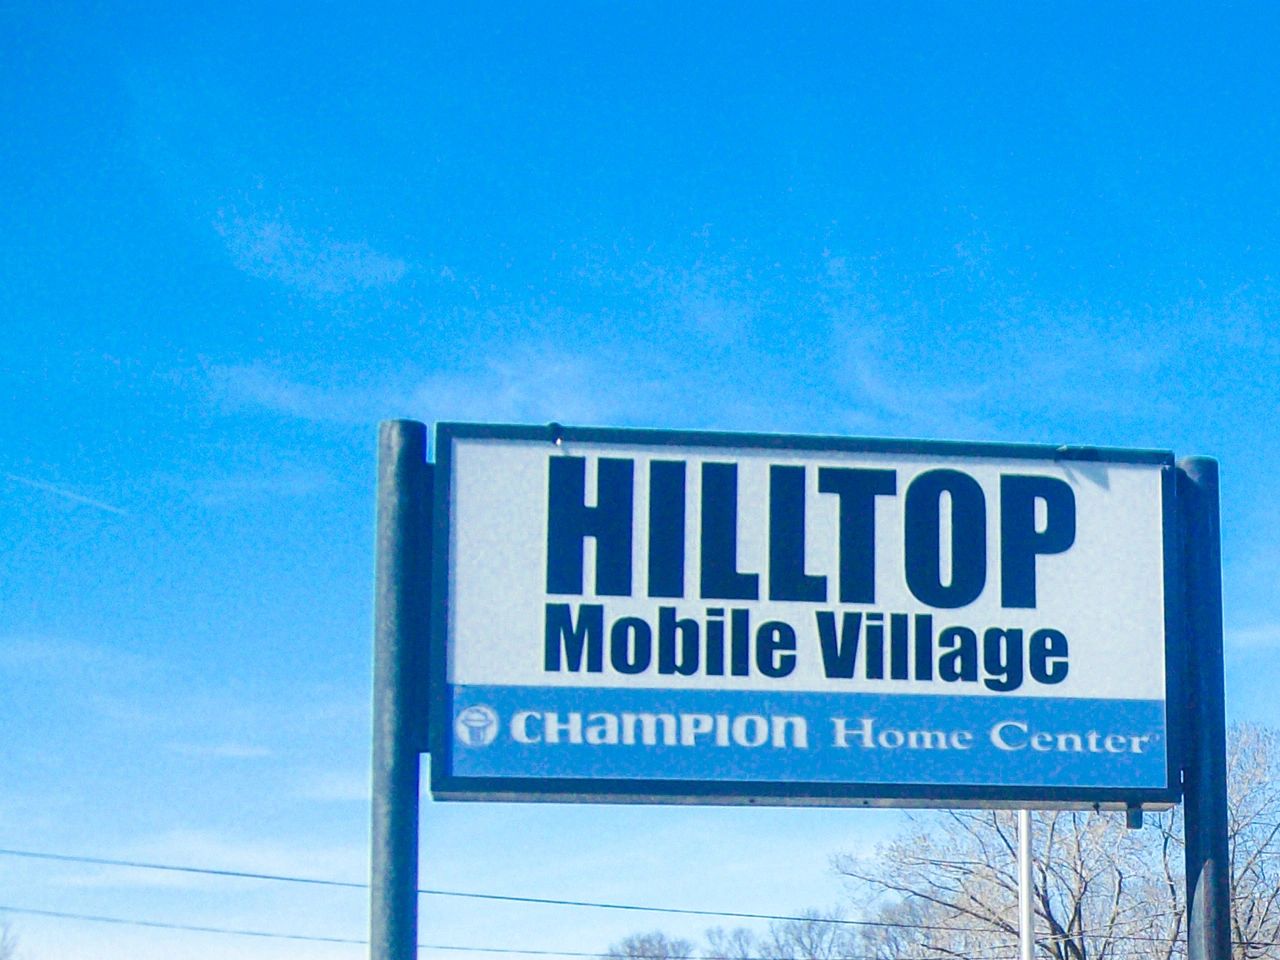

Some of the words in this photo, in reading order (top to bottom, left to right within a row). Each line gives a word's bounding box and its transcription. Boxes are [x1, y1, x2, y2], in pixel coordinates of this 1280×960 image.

[546, 455, 1077, 609] HILLTOP
[544, 603, 797, 679] Mobile
[815, 611, 1069, 693] Village
[831, 717, 973, 750] Home
[990, 721, 1150, 754] Center
